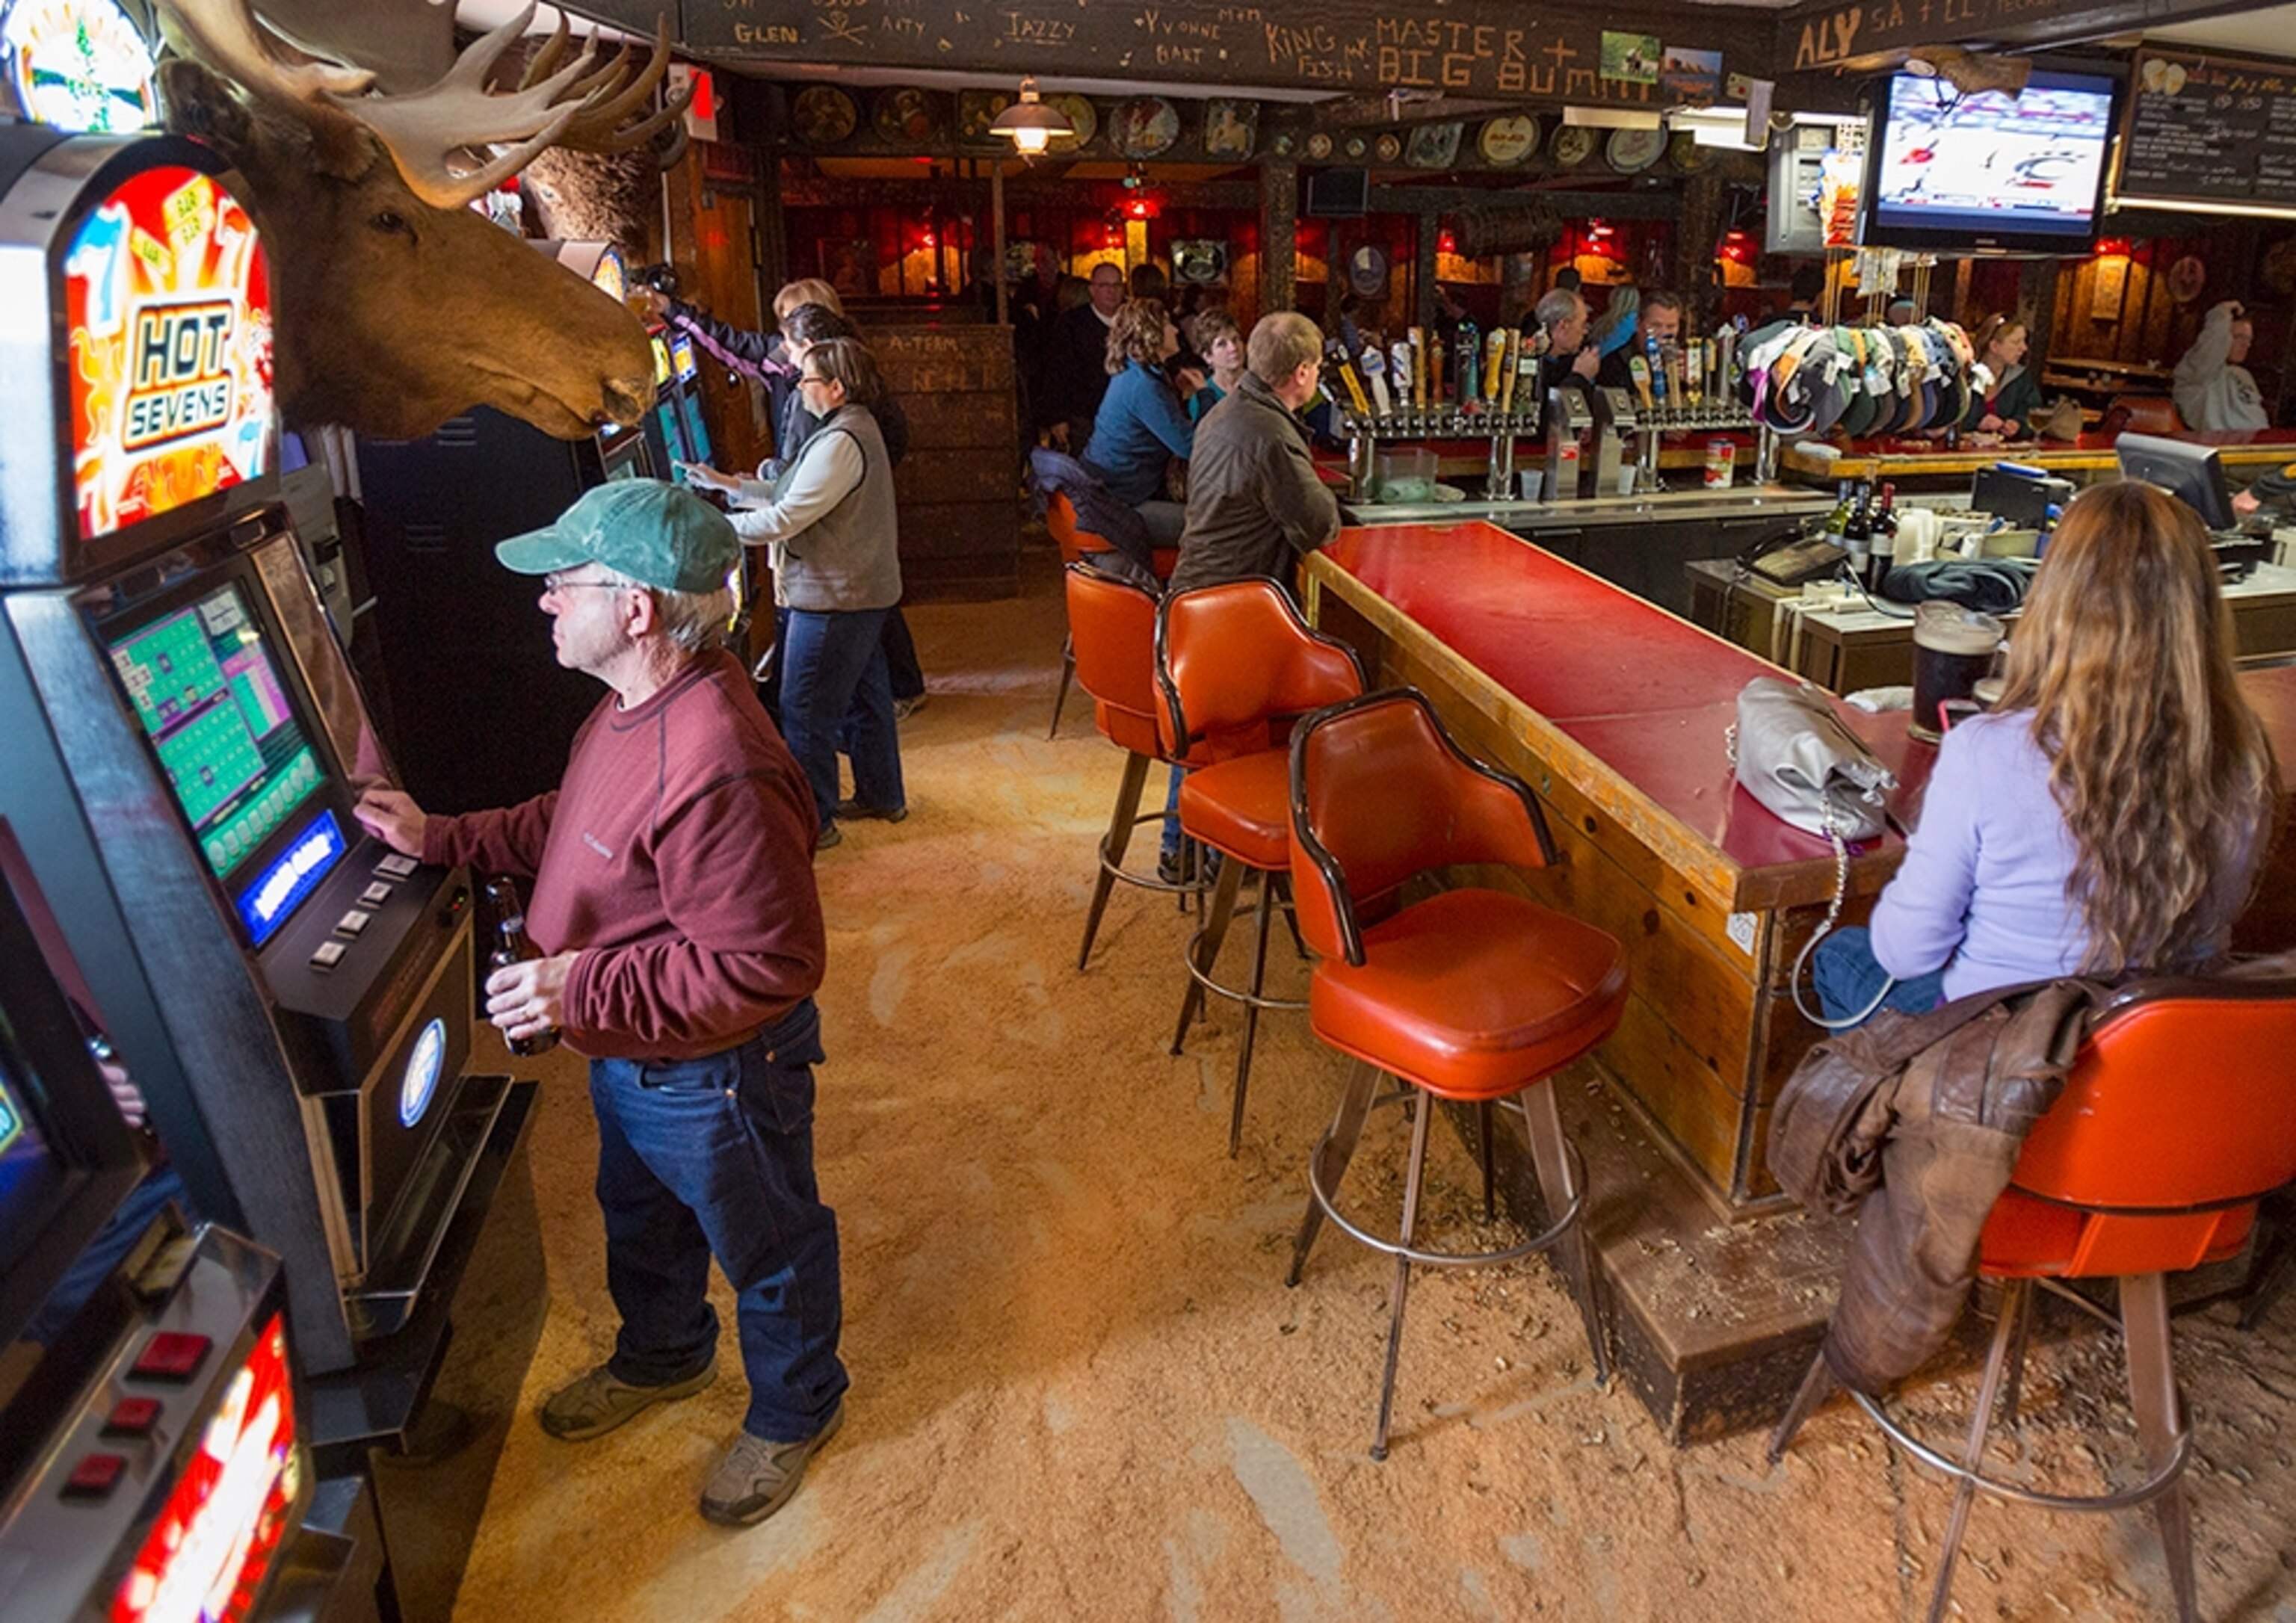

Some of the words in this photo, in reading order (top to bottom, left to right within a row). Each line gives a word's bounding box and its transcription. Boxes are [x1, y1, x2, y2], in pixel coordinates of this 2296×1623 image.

[734, 23, 798, 43] GLEN
[1377, 18, 1526, 61] MASTER
[1795, 7, 1862, 69] ALY
[1379, 46, 1475, 86] BIG
[141, 314, 226, 383] HOT
[130, 383, 226, 438] SEVENS
